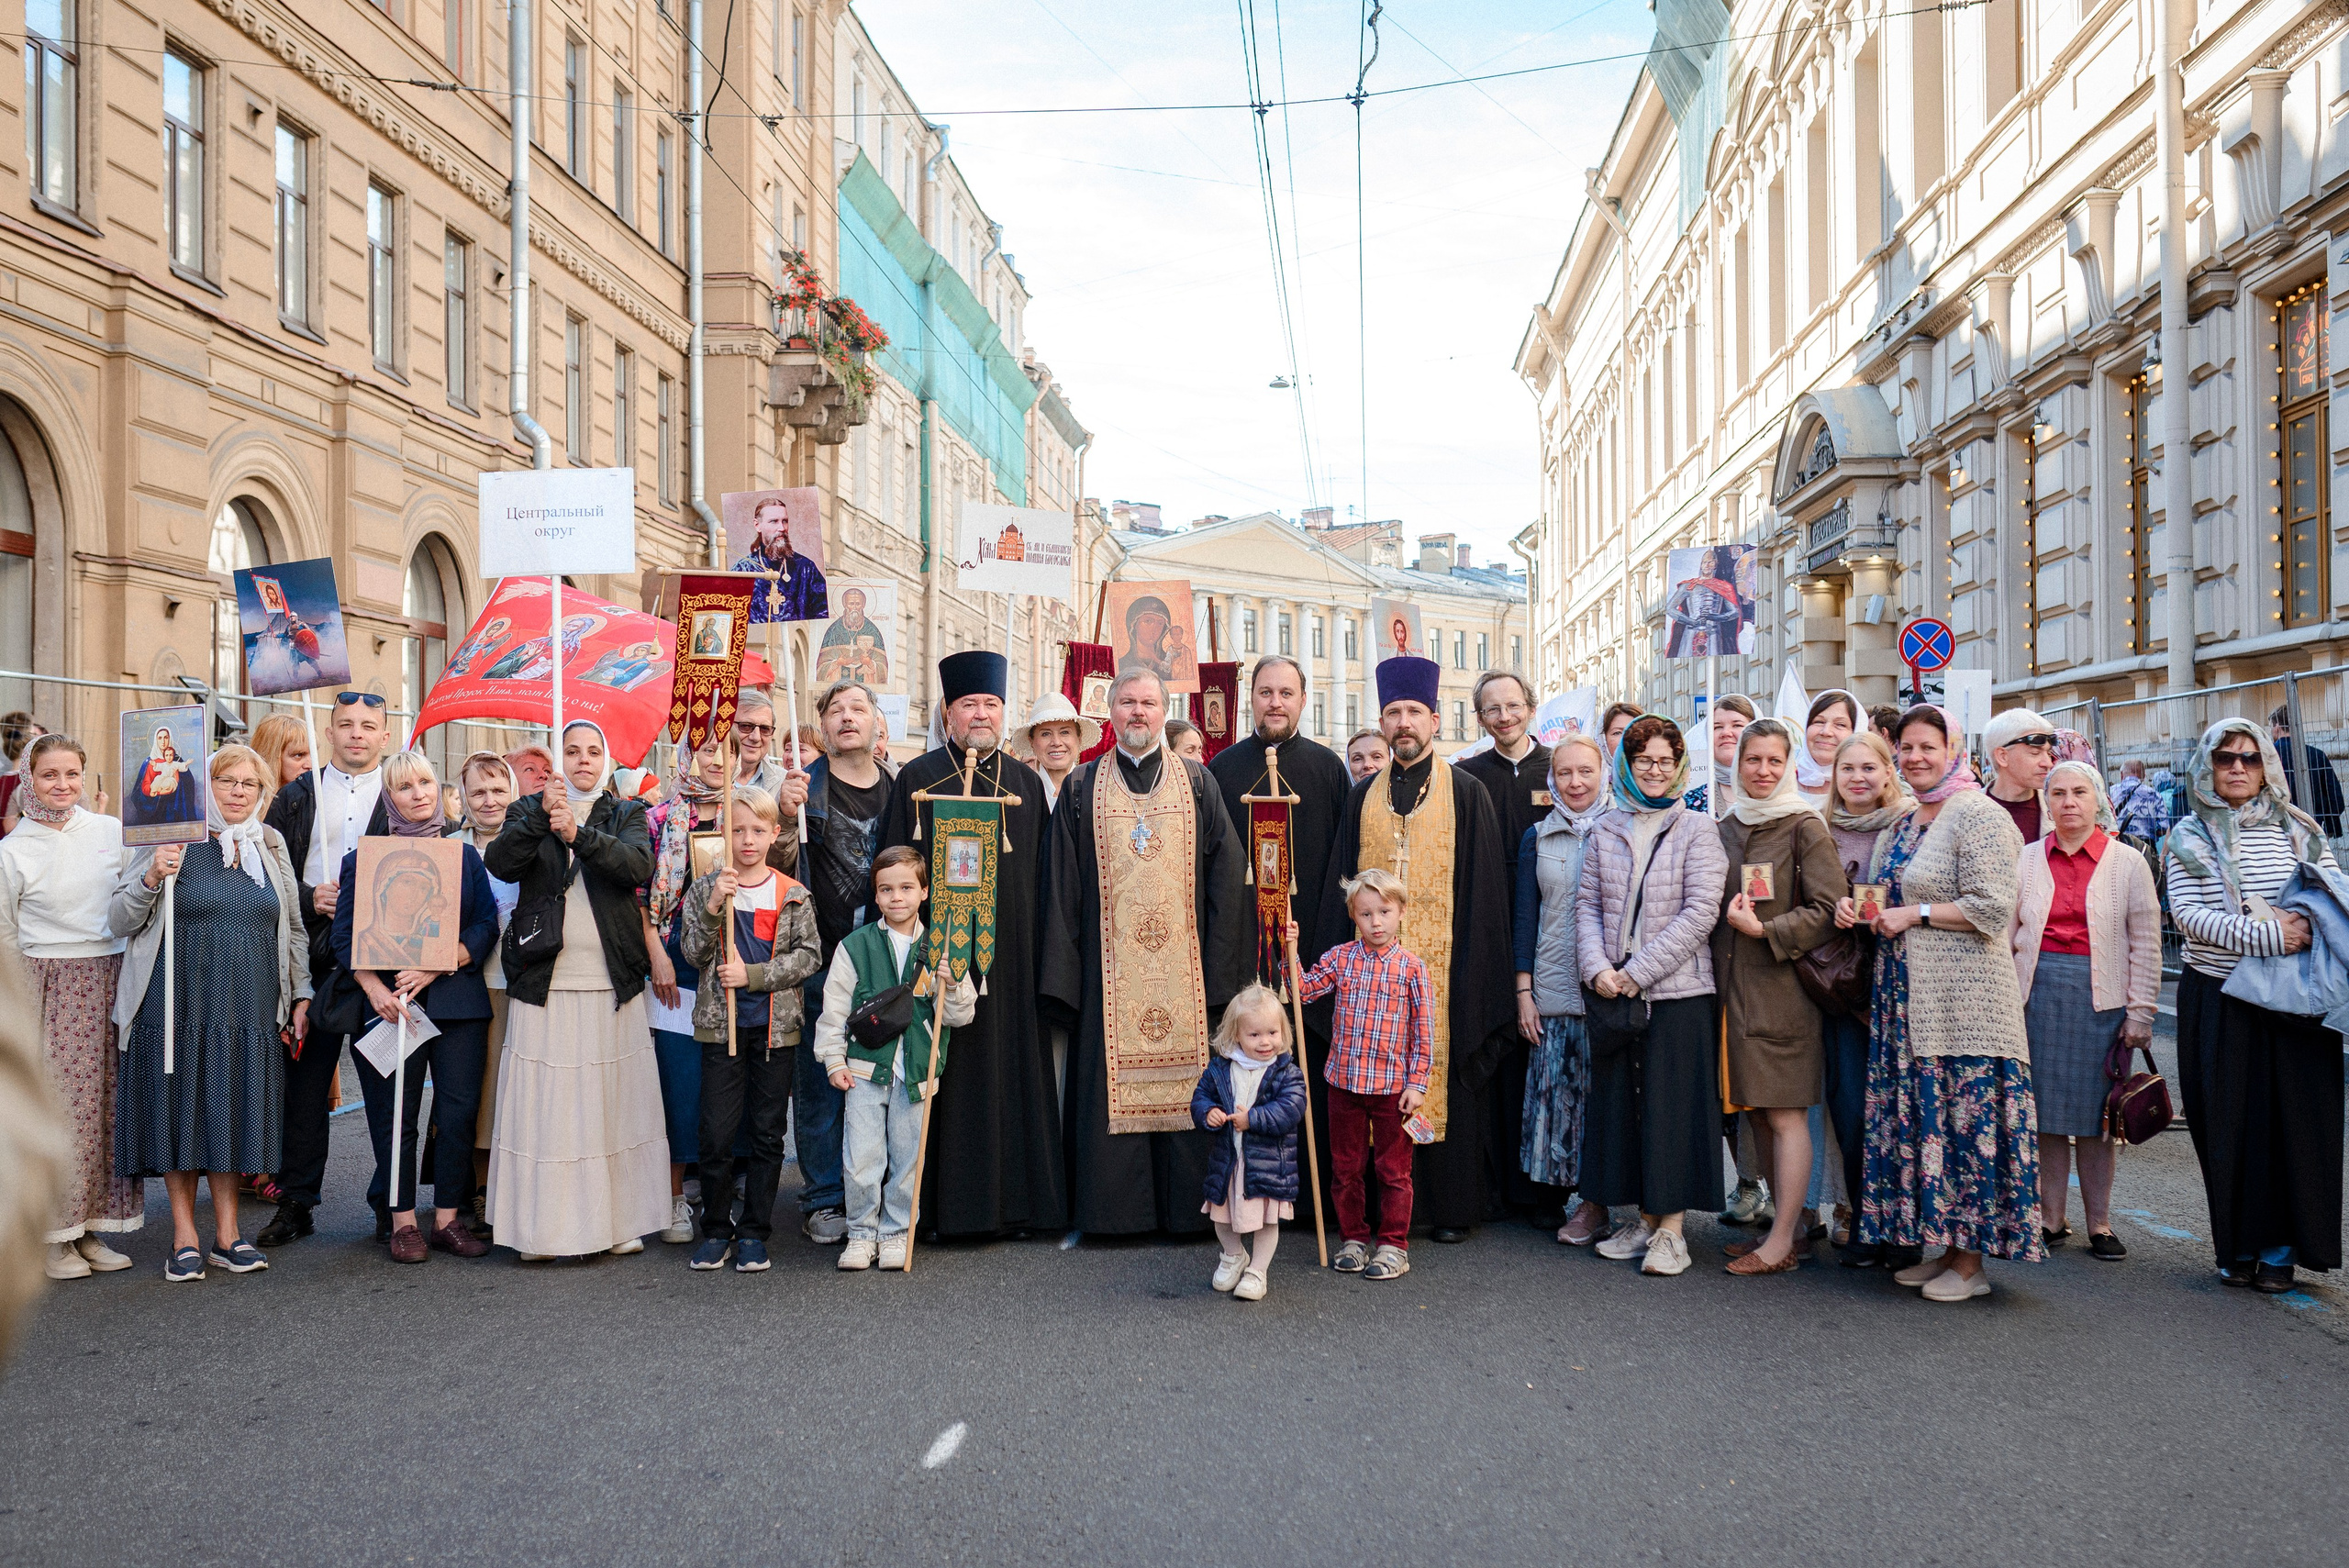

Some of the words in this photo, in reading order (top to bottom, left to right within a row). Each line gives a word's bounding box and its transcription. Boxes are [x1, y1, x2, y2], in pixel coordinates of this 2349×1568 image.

[507, 505, 604, 520] Центральный
[1812, 508, 1845, 544] РЕСТОРАН
[534, 527, 576, 539] округ
[452, 687, 485, 699] Пророк
